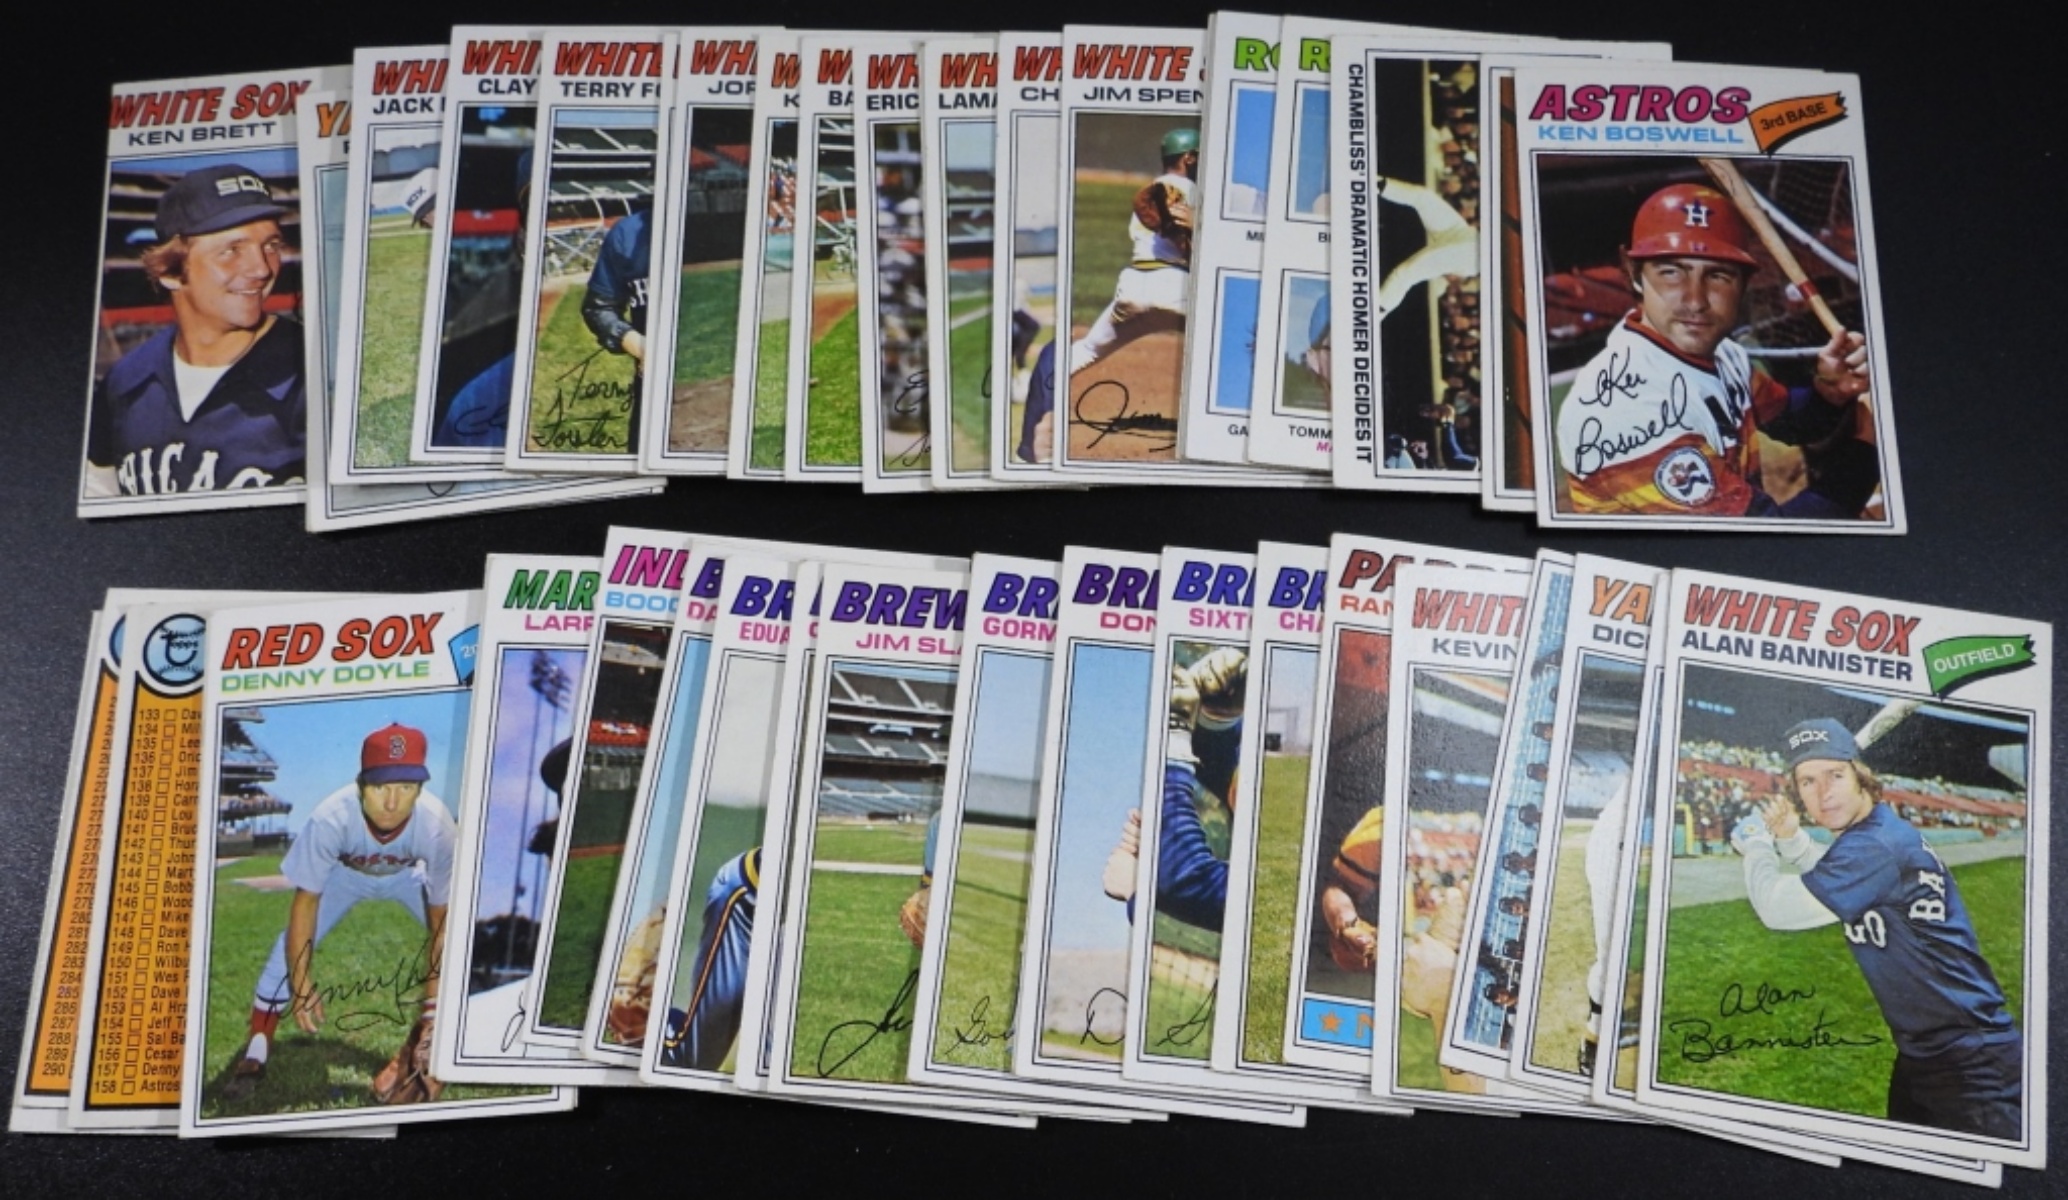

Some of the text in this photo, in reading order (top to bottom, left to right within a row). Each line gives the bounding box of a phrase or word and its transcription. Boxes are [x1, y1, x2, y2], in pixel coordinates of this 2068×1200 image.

[1073, 43, 1193, 81] WHITE
[478, 79, 537, 95] CLAY
[560, 81, 635, 98] TERRY
[1020, 87, 1060, 101] CH
[1083, 87, 1131, 101] JIM
[108, 86, 225, 129] WHITE
[230, 80, 312, 120] SOX
[373, 97, 434, 116] JACK
[866, 94, 919, 111] ERIC
[1529, 83, 1752, 124] ASTROS
[1759, 102, 1828, 131] 3rd BASE
[128, 121, 277, 147] KEN BRETT
[1537, 125, 1744, 144] KEN BOSWELL
[1348, 63, 1372, 463] CHAMBLISS' DRAMATIC HOMER DECIDES IT
[503, 569, 601, 611] MAR
[1683, 583, 1920, 657] WHITE SOX
[221, 612, 444, 671] RED SOX
[856, 633, 909, 651] JIM
[1432, 638, 1517, 660] KEVIN
[1681, 630, 1913, 682] ALAN BANNISTER
[1933, 640, 2017, 674] OUTFIELD
[221, 660, 430, 693] DENNY DOYLE
[1789, 725, 1829, 750] SOX
[159, 925, 187, 938] Dave
[151, 985, 180, 998] Dave
[145, 1048, 180, 1060] Cesar
[42, 1062, 65, 1076] 290
[143, 1062, 181, 1077] Denny
